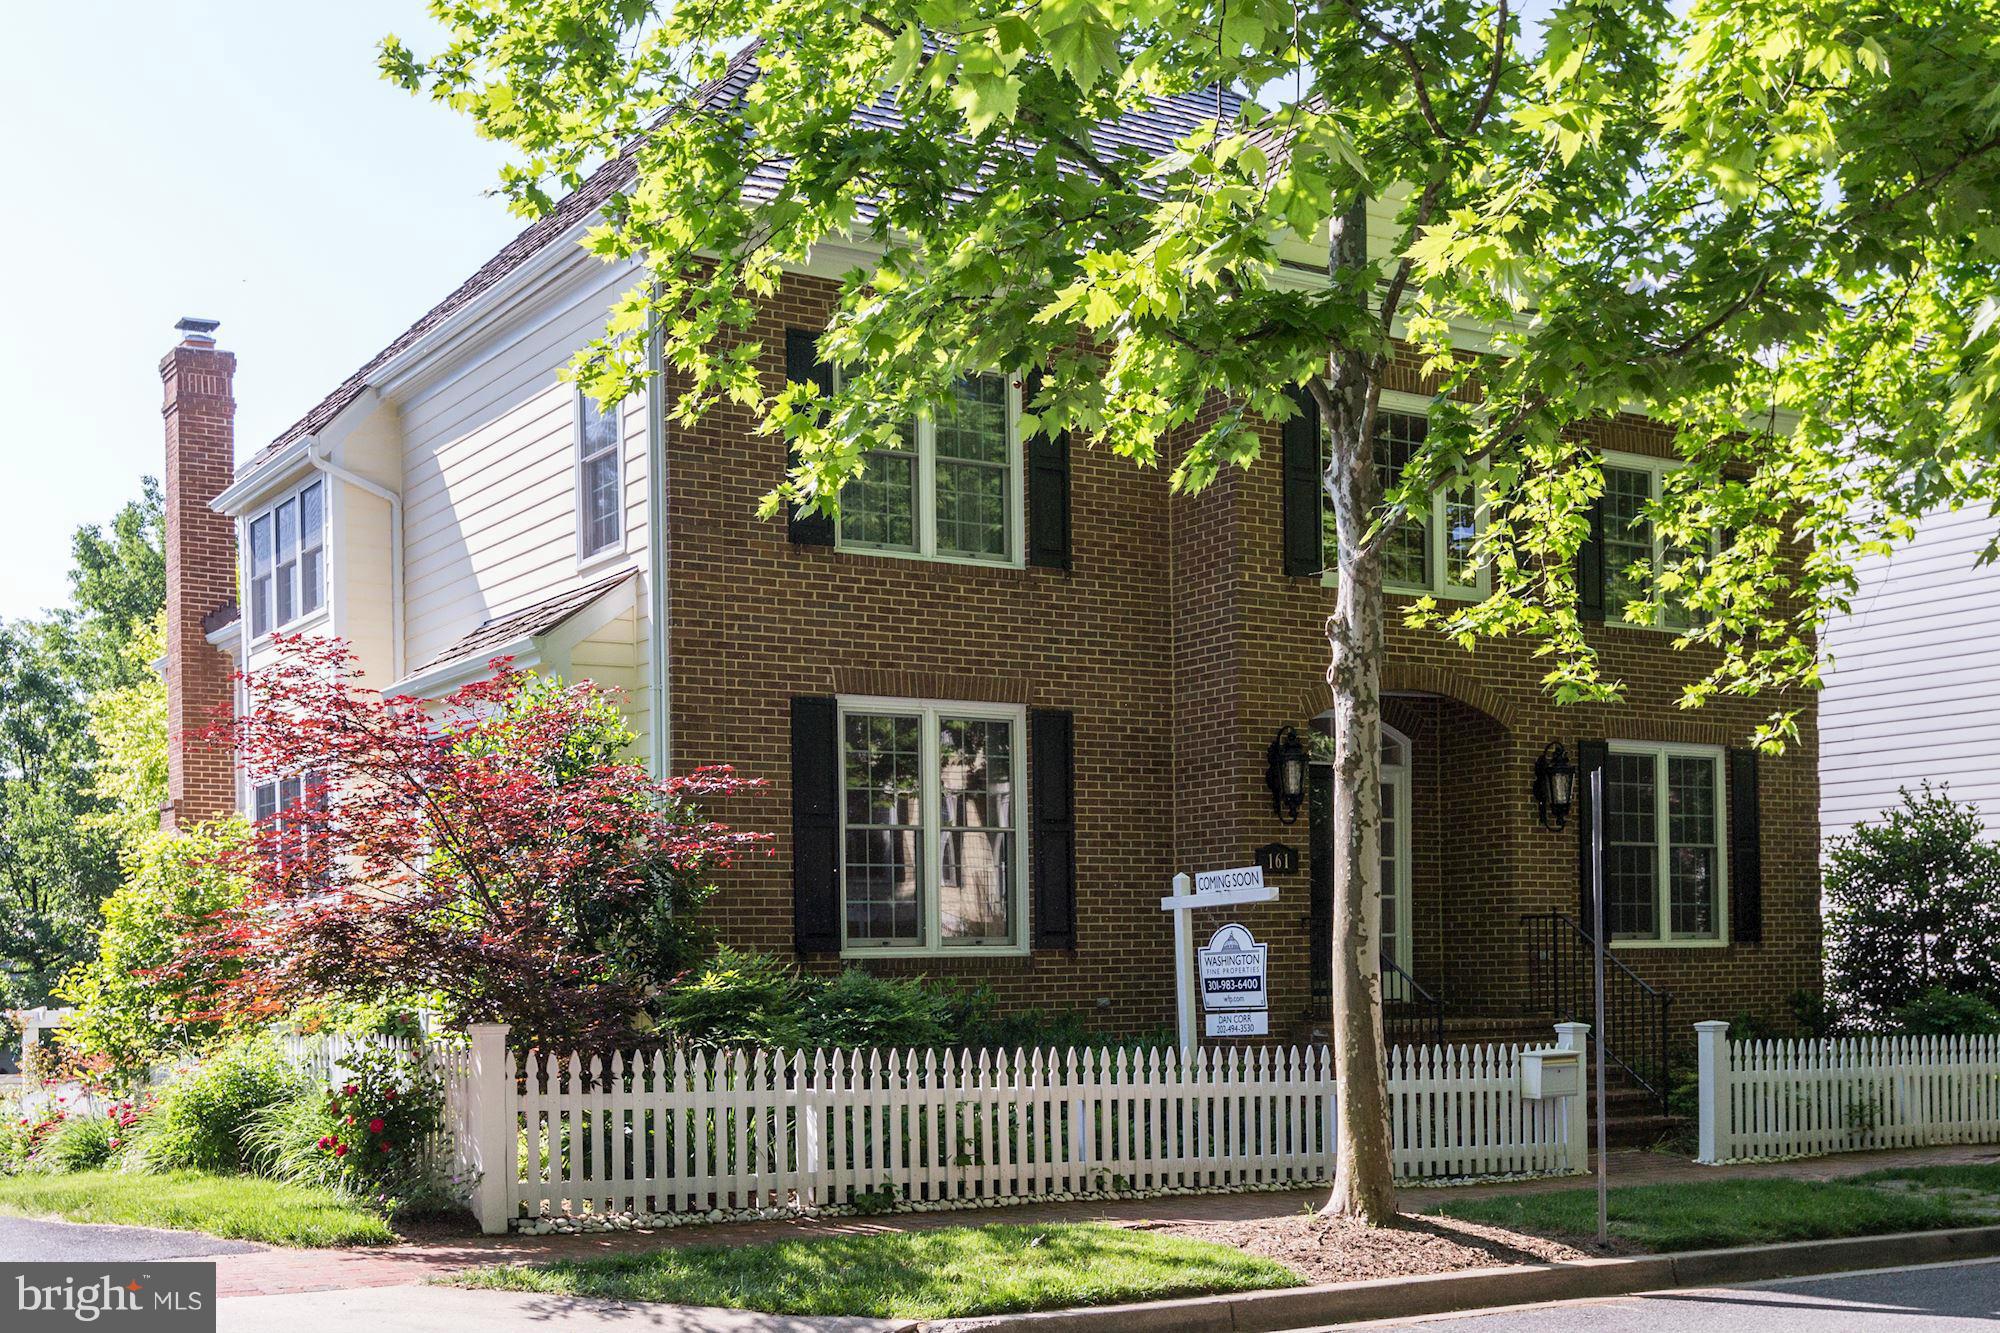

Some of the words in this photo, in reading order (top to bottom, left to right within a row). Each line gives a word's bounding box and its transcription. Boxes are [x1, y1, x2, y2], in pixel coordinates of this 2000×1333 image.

[1269, 853, 1289, 870] 161
[1198, 874, 1231, 891] COMING
[1232, 871, 1260, 887] SOON
[1204, 954, 1260, 967] WASHINGTON
[1223, 966, 1260, 974] PROPERTIES
[1207, 978, 1259, 991] 301-983-6400
[1223, 994, 1245, 1004] wfp.com
[1218, 1015, 1232, 1024] DAN
[1233, 1014, 1252, 1023] CORR
[1216, 1023, 1255, 1034] 202-494-3530
